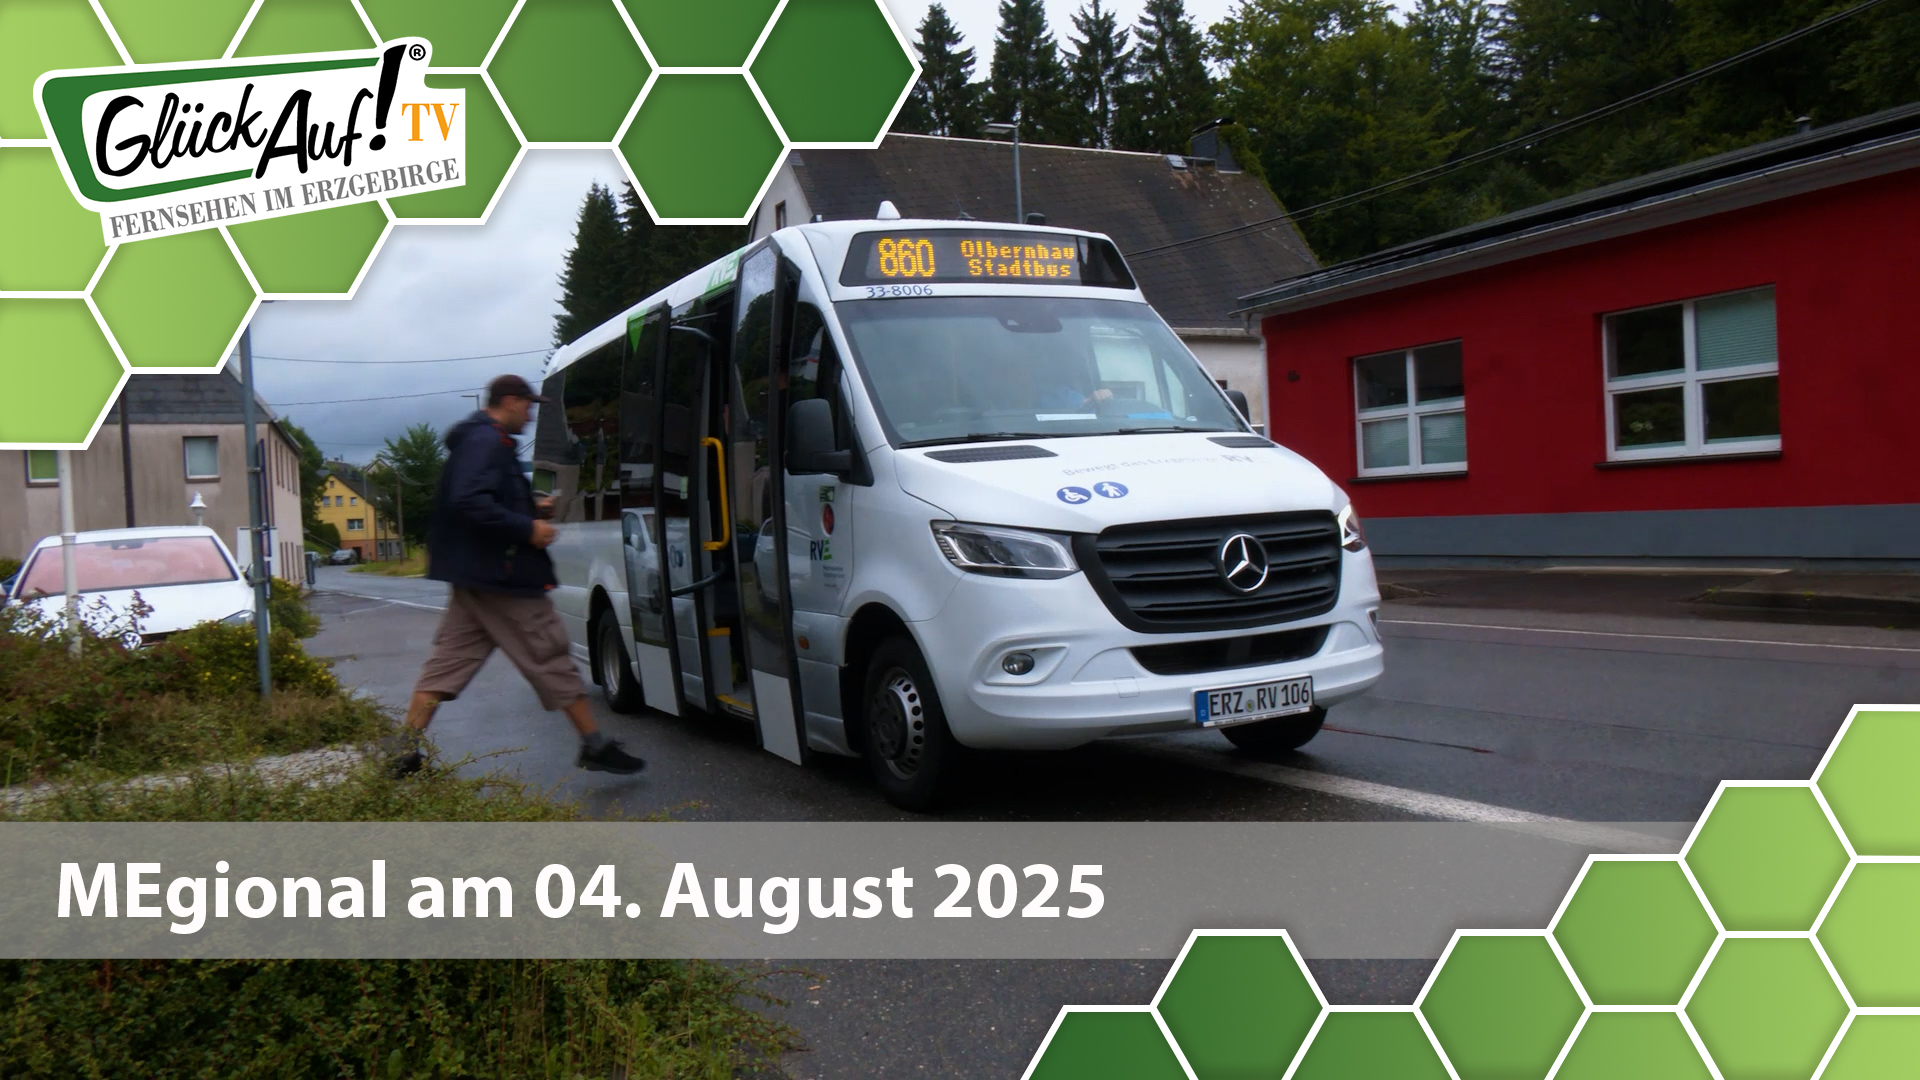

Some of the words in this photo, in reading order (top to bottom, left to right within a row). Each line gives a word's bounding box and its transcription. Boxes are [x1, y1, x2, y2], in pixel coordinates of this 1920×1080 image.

[878, 238, 936, 277] 860
[960, 240, 1075, 260] Olbernhau
[968, 259, 1071, 277] Stadtbus
[866, 284, 933, 298] 33-8006
[1062, 463, 1119, 477] Bewegt
[810, 539, 832, 560] RVE
[1209, 691, 1244, 717] ERZ
[1256, 686, 1278, 710] RV
[1281, 682, 1310, 707] 106
